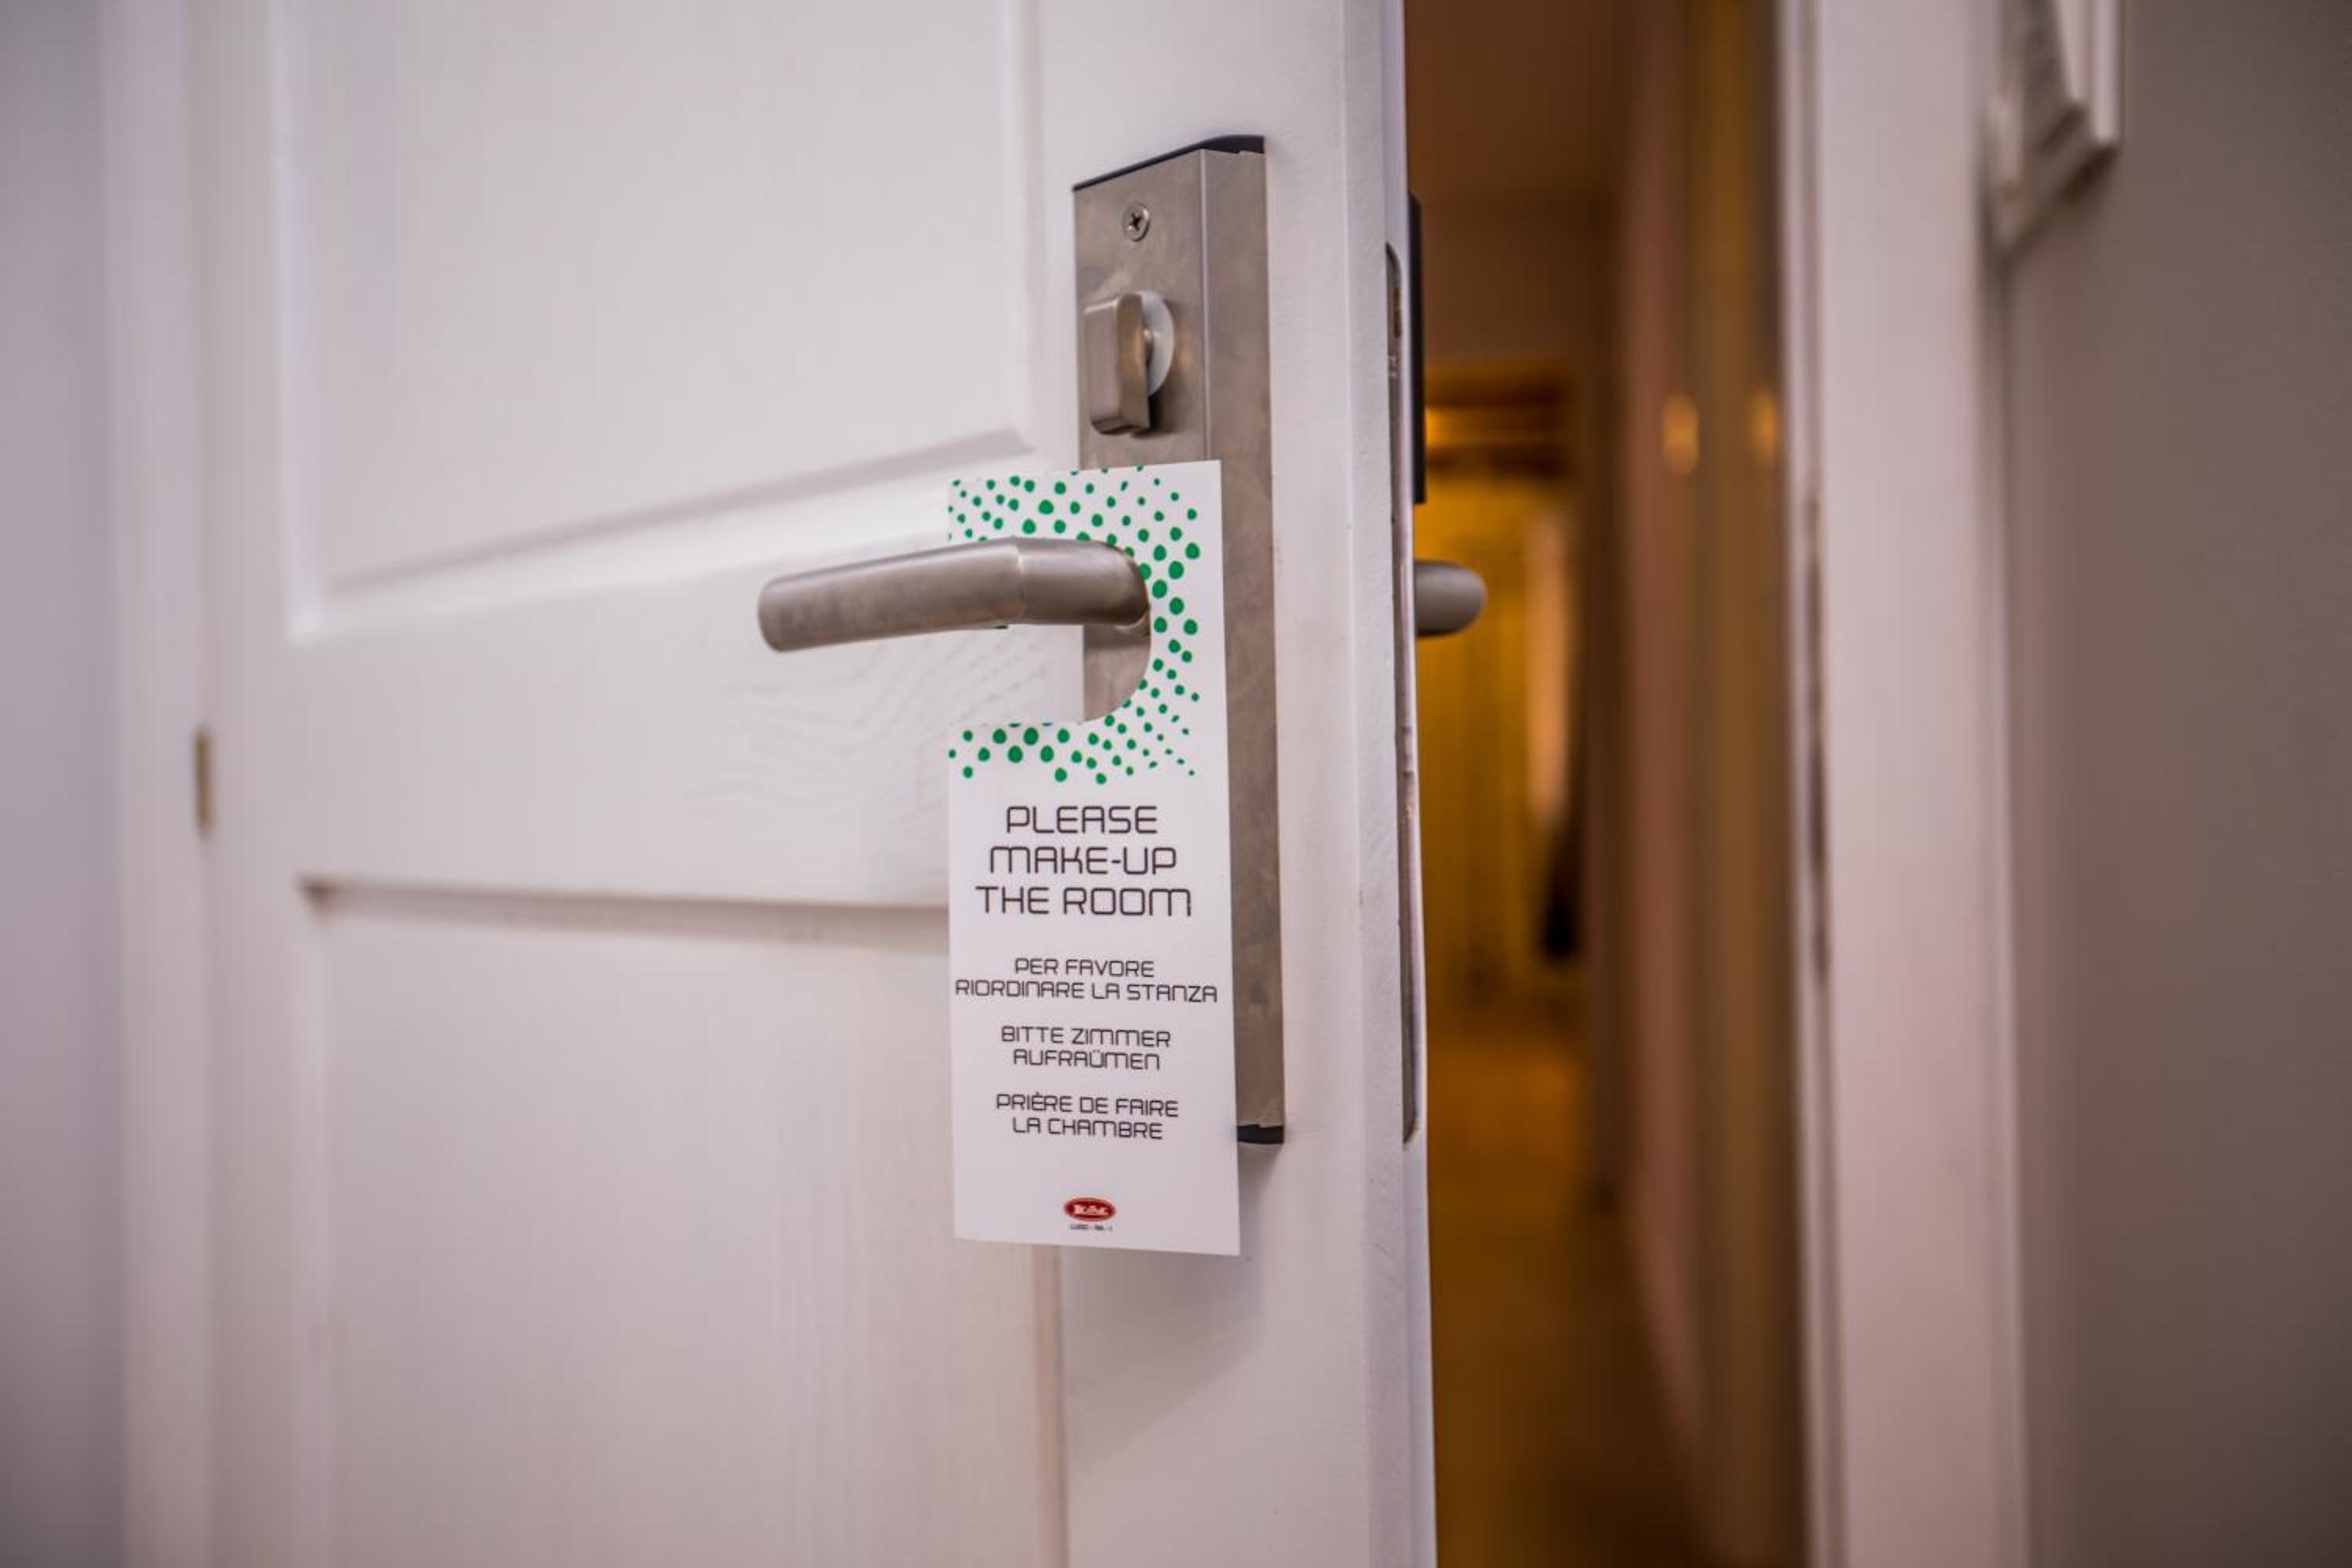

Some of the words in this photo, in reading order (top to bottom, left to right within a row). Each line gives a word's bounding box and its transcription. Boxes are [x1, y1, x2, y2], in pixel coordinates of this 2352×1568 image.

[1006, 805, 1158, 834] PLEASE
[990, 846, 1178, 875] MAKE-UP
[975, 885, 1050, 915] THE
[1063, 887, 1192, 916] ROOM
[1015, 957, 1058, 975] PER
[1065, 959, 1155, 978] FAVORE
[955, 979, 1084, 1000] RIORDINARE
[1092, 982, 1120, 1000] LA
[1127, 984, 1218, 1003] STANZA
[1001, 1025, 1064, 1044] BITTE
[1072, 1028, 1171, 1047] ZIMMER
[996, 1091, 1073, 1113] PRIÈRE
[1080, 1096, 1109, 1114] DE
[1116, 1098, 1179, 1117] FAIRE
[1012, 1117, 1041, 1134] LA
[1048, 1118, 1163, 1140] CHAMBRE
